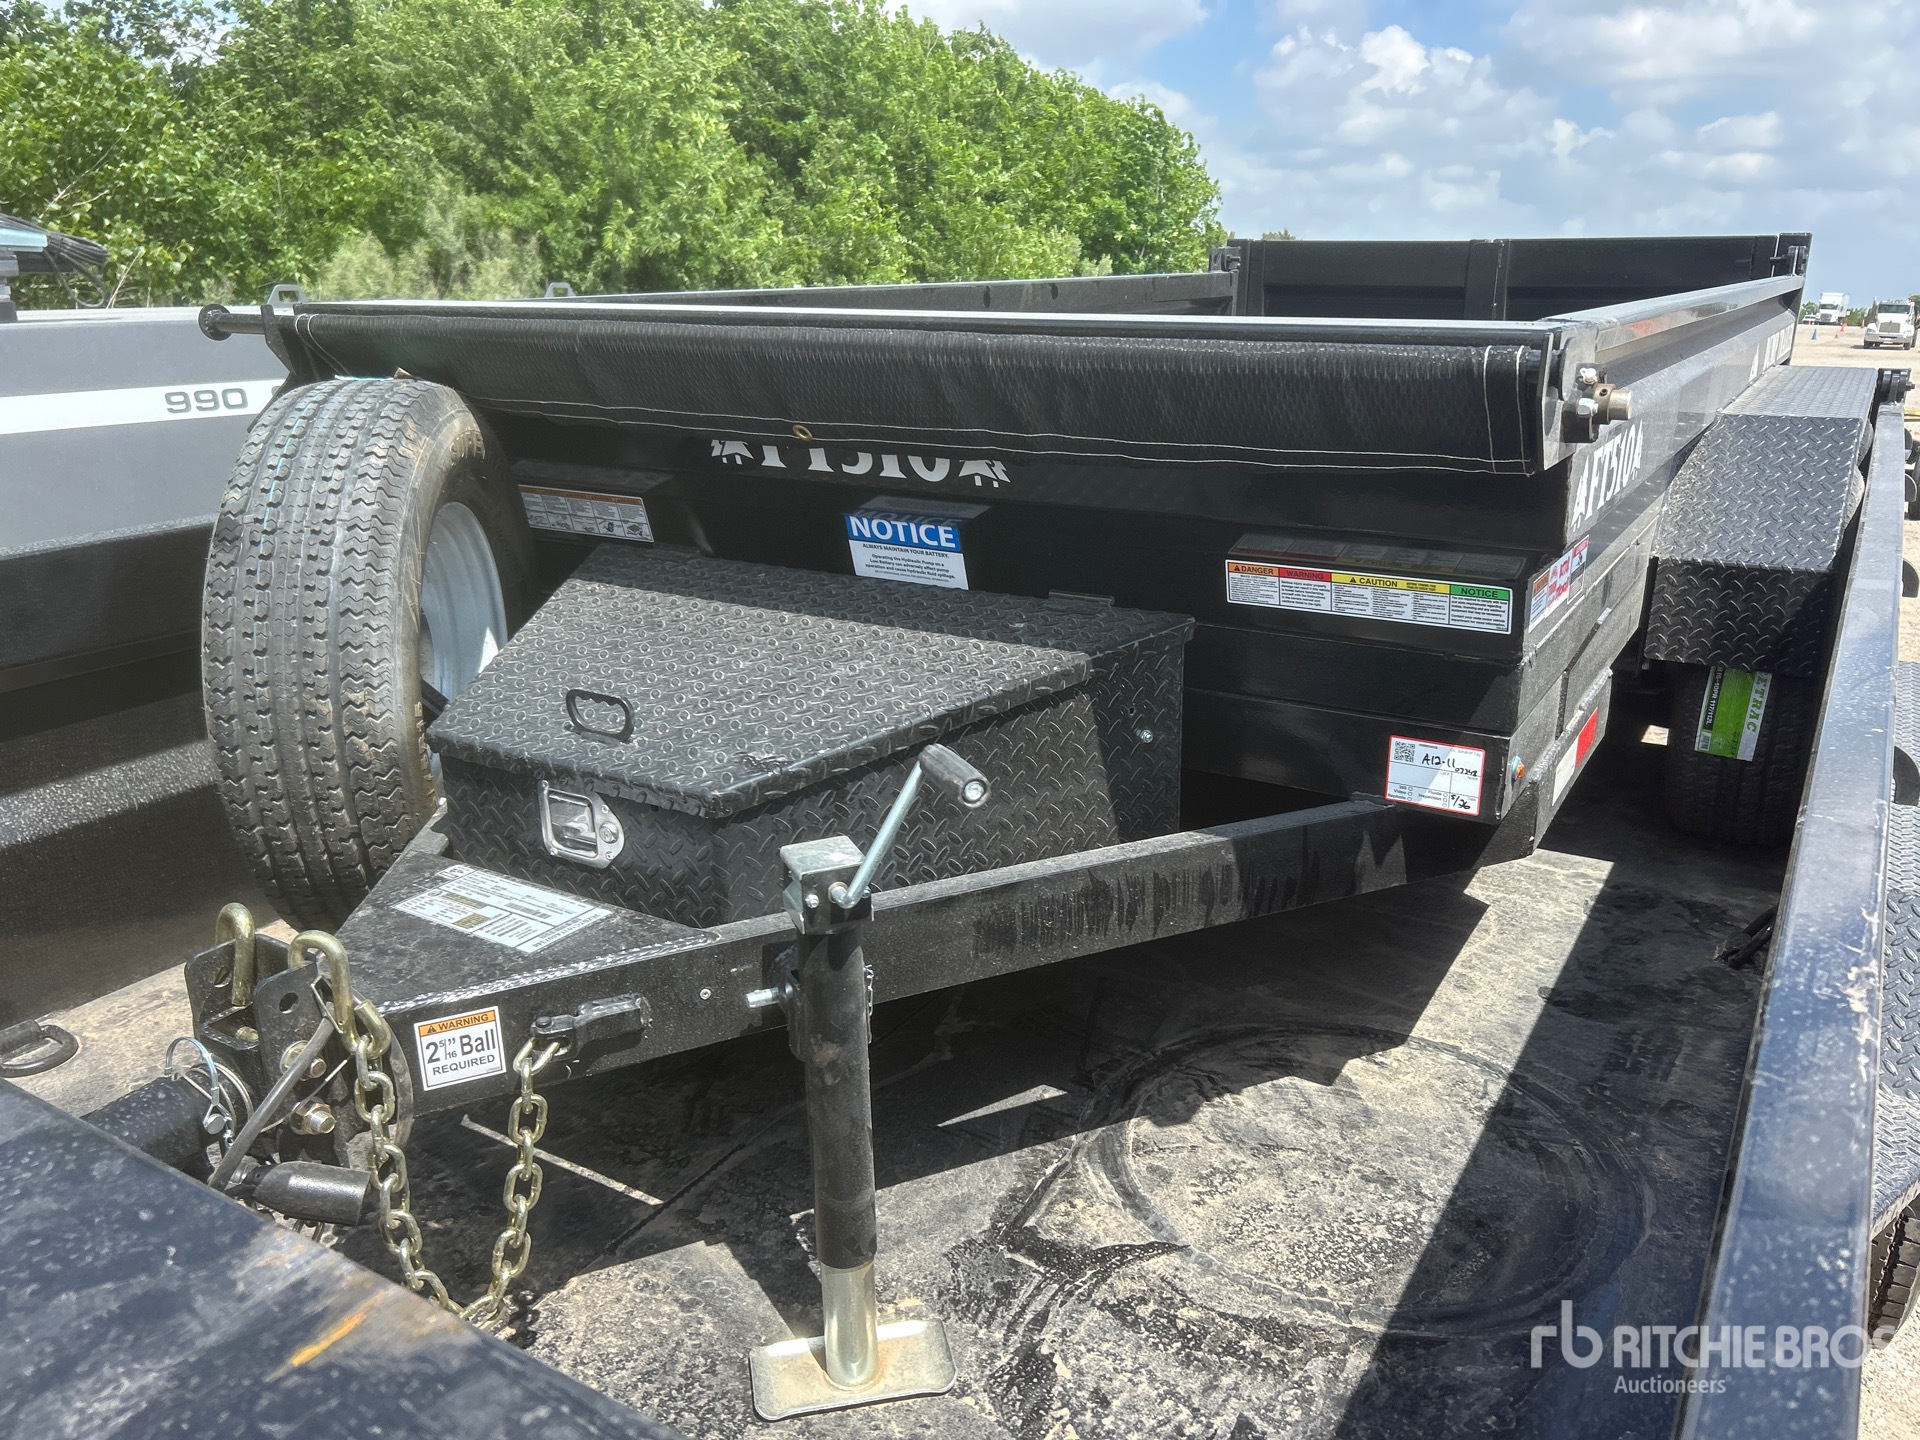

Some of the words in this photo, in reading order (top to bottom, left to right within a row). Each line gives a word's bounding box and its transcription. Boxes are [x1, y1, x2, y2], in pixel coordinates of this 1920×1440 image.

[164, 388, 248, 414] 990
[849, 516, 956, 548] NOTICE
[1242, 566, 1274, 575] DANGER
[1286, 570, 1324, 580] WARNING
[1359, 578, 1398, 587] CAUTION
[1461, 588, 1498, 598] NOTICE
[1422, 753, 1455, 768] A12-11
[1450, 795, 1470, 809] 5/26
[438, 1014, 488, 1030] WARNING
[459, 1028, 495, 1056] Ball
[432, 1054, 495, 1075] REQUIRED
